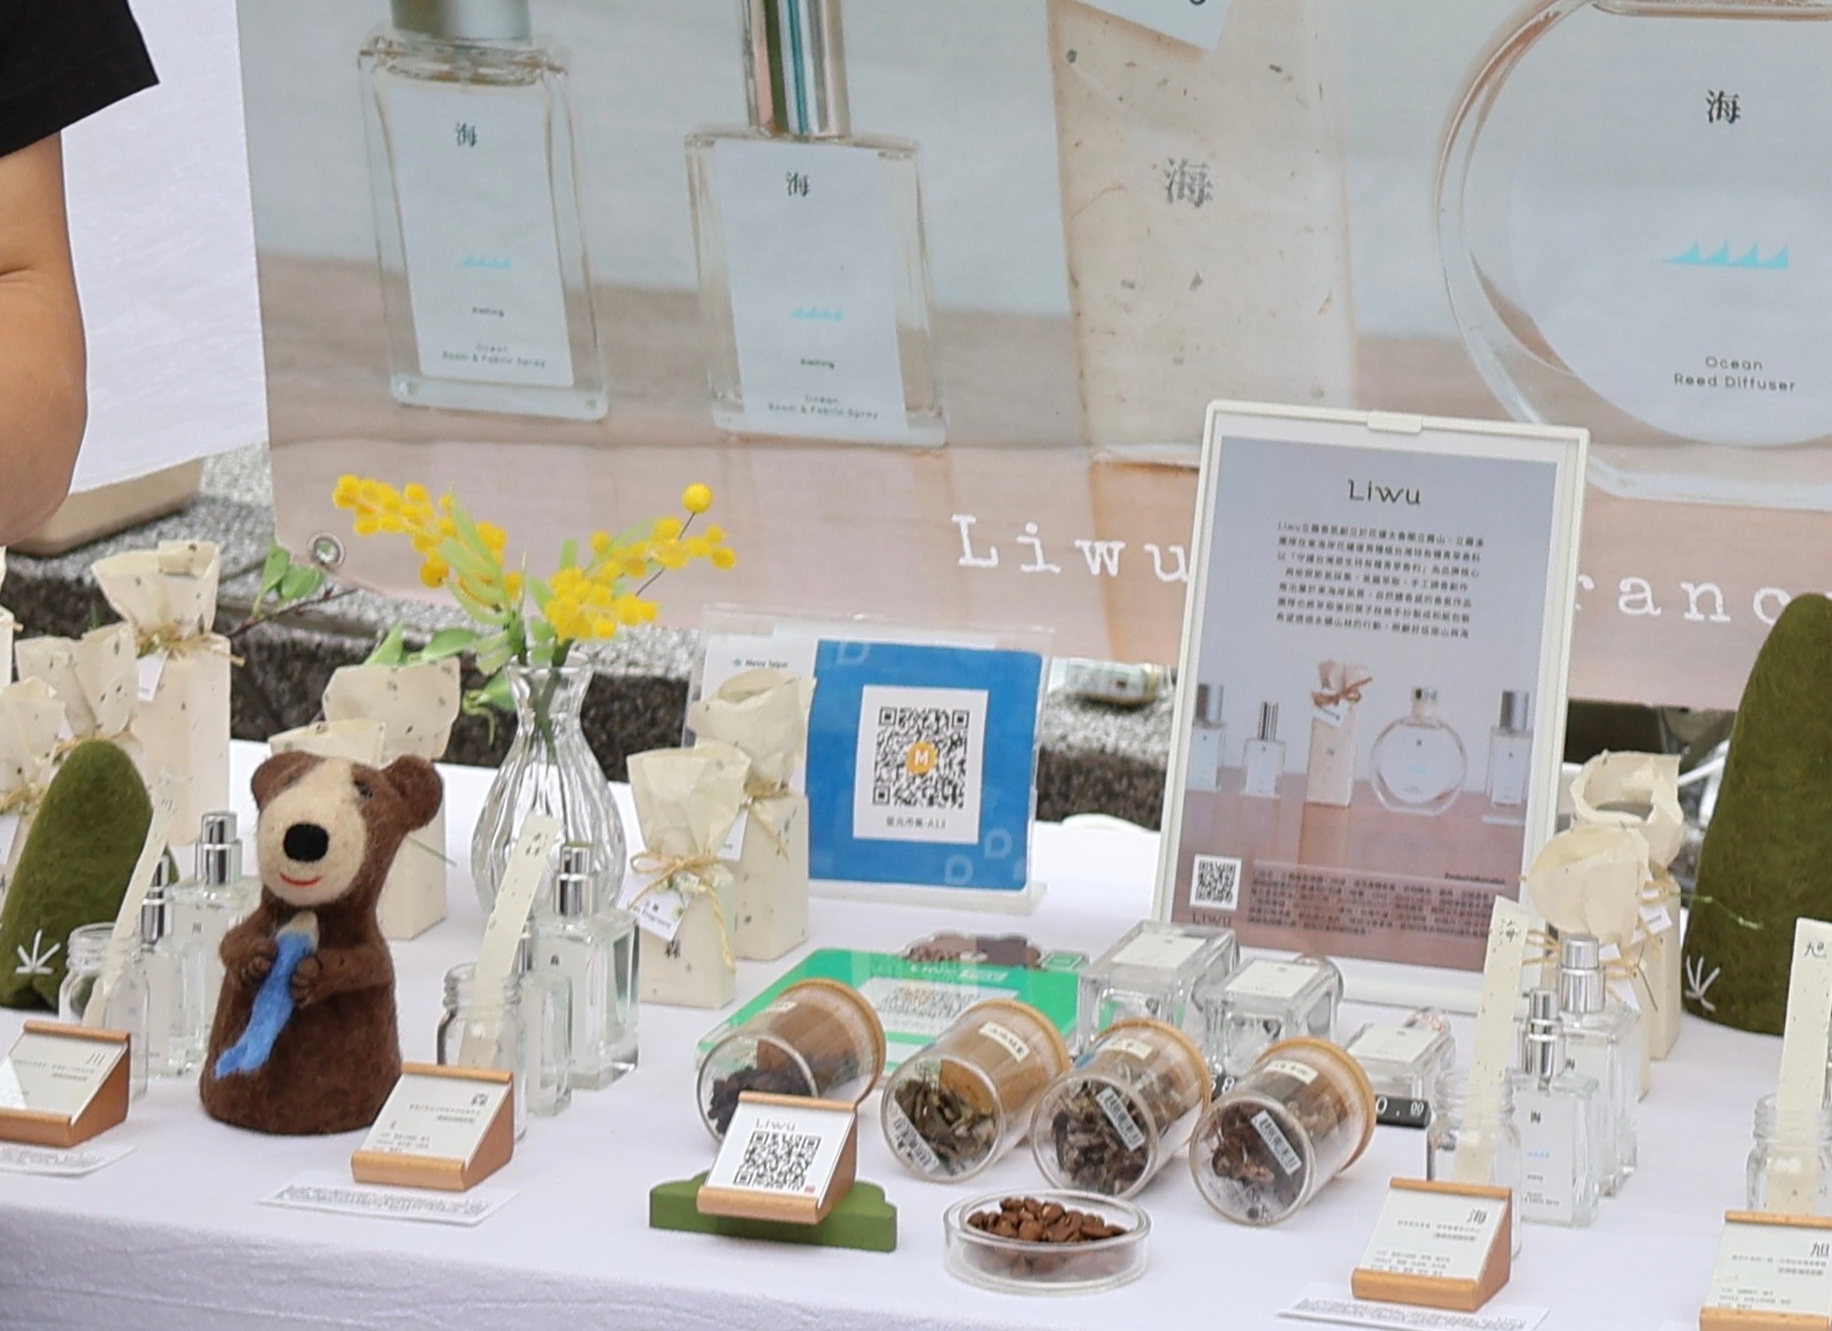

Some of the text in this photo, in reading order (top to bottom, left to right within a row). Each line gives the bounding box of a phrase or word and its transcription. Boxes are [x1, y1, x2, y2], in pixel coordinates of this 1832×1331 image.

[1705, 89, 1741, 125] 海
[1164, 157, 1213, 208] 海
[1704, 356, 1763, 371] Ocean
[1673, 372, 1796, 392] Reed Diffuser
[1347, 477, 1422, 506] Liwu
[951, 513, 1189, 583] Liwu
[914, 748, 929, 765] M
[1810, 1241, 1830, 1258] 旭
